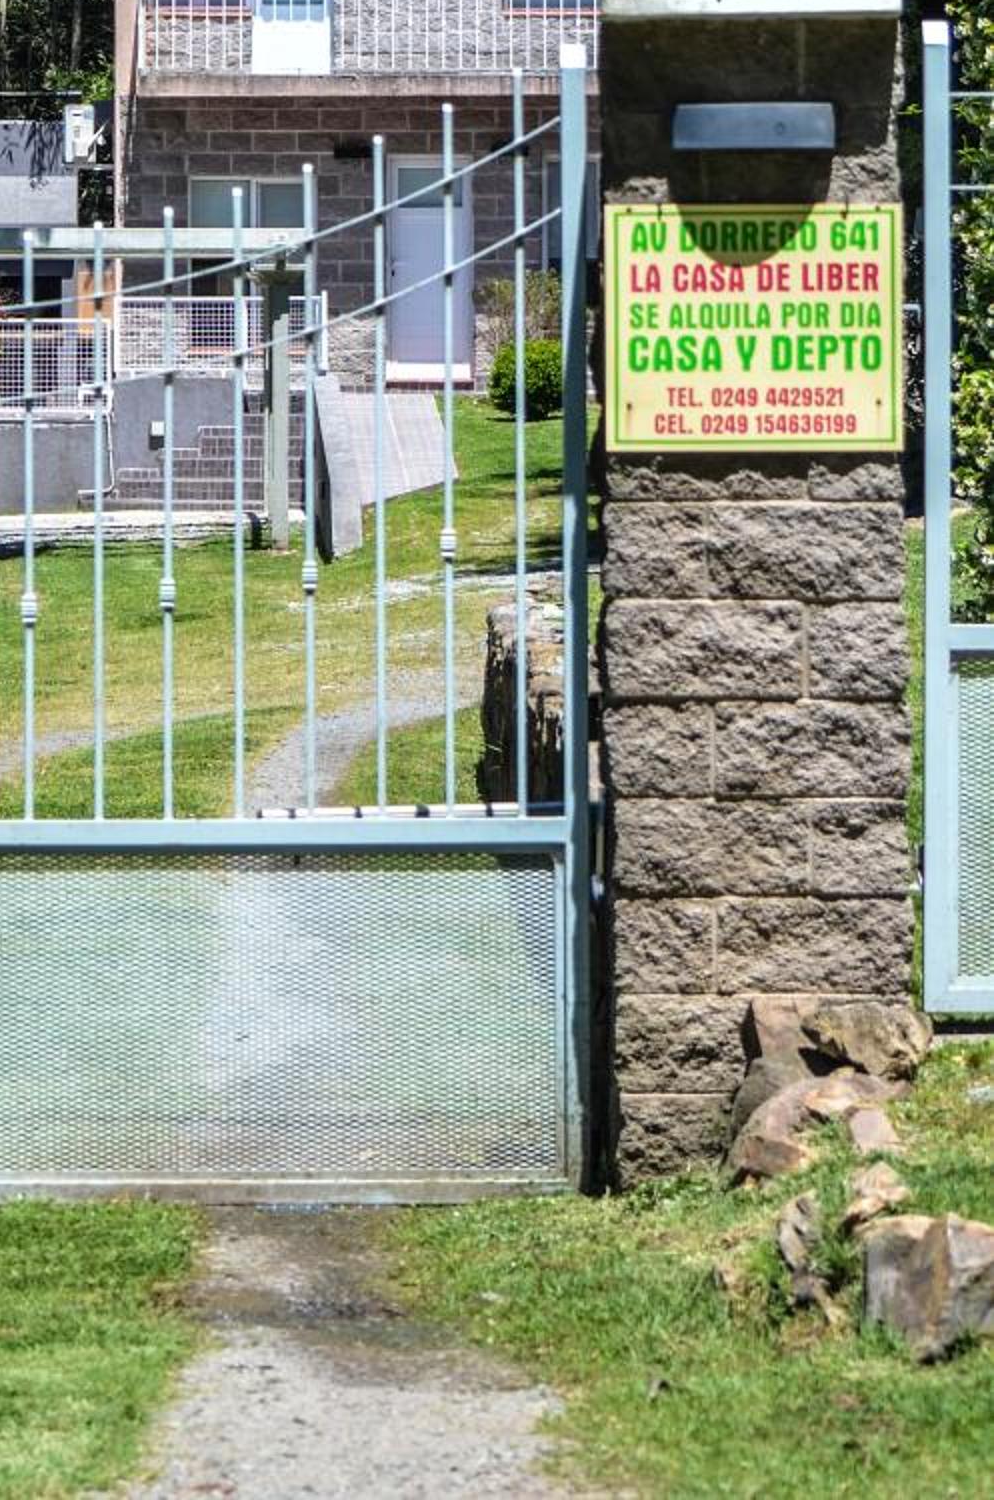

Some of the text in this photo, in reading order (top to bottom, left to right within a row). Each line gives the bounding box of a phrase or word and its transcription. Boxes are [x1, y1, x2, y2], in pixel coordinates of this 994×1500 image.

[631, 220, 879, 252] AV DORREGO 641
[631, 263, 879, 292] LA CASA DE LIBER
[630, 303, 881, 329] SE ALQUILA POR DIA
[628, 335, 882, 372] CASA Y DEPTO
[667, 388, 844, 407] TEL. 0249 4429521
[655, 415, 856, 434] CEL. 0249 154636199
